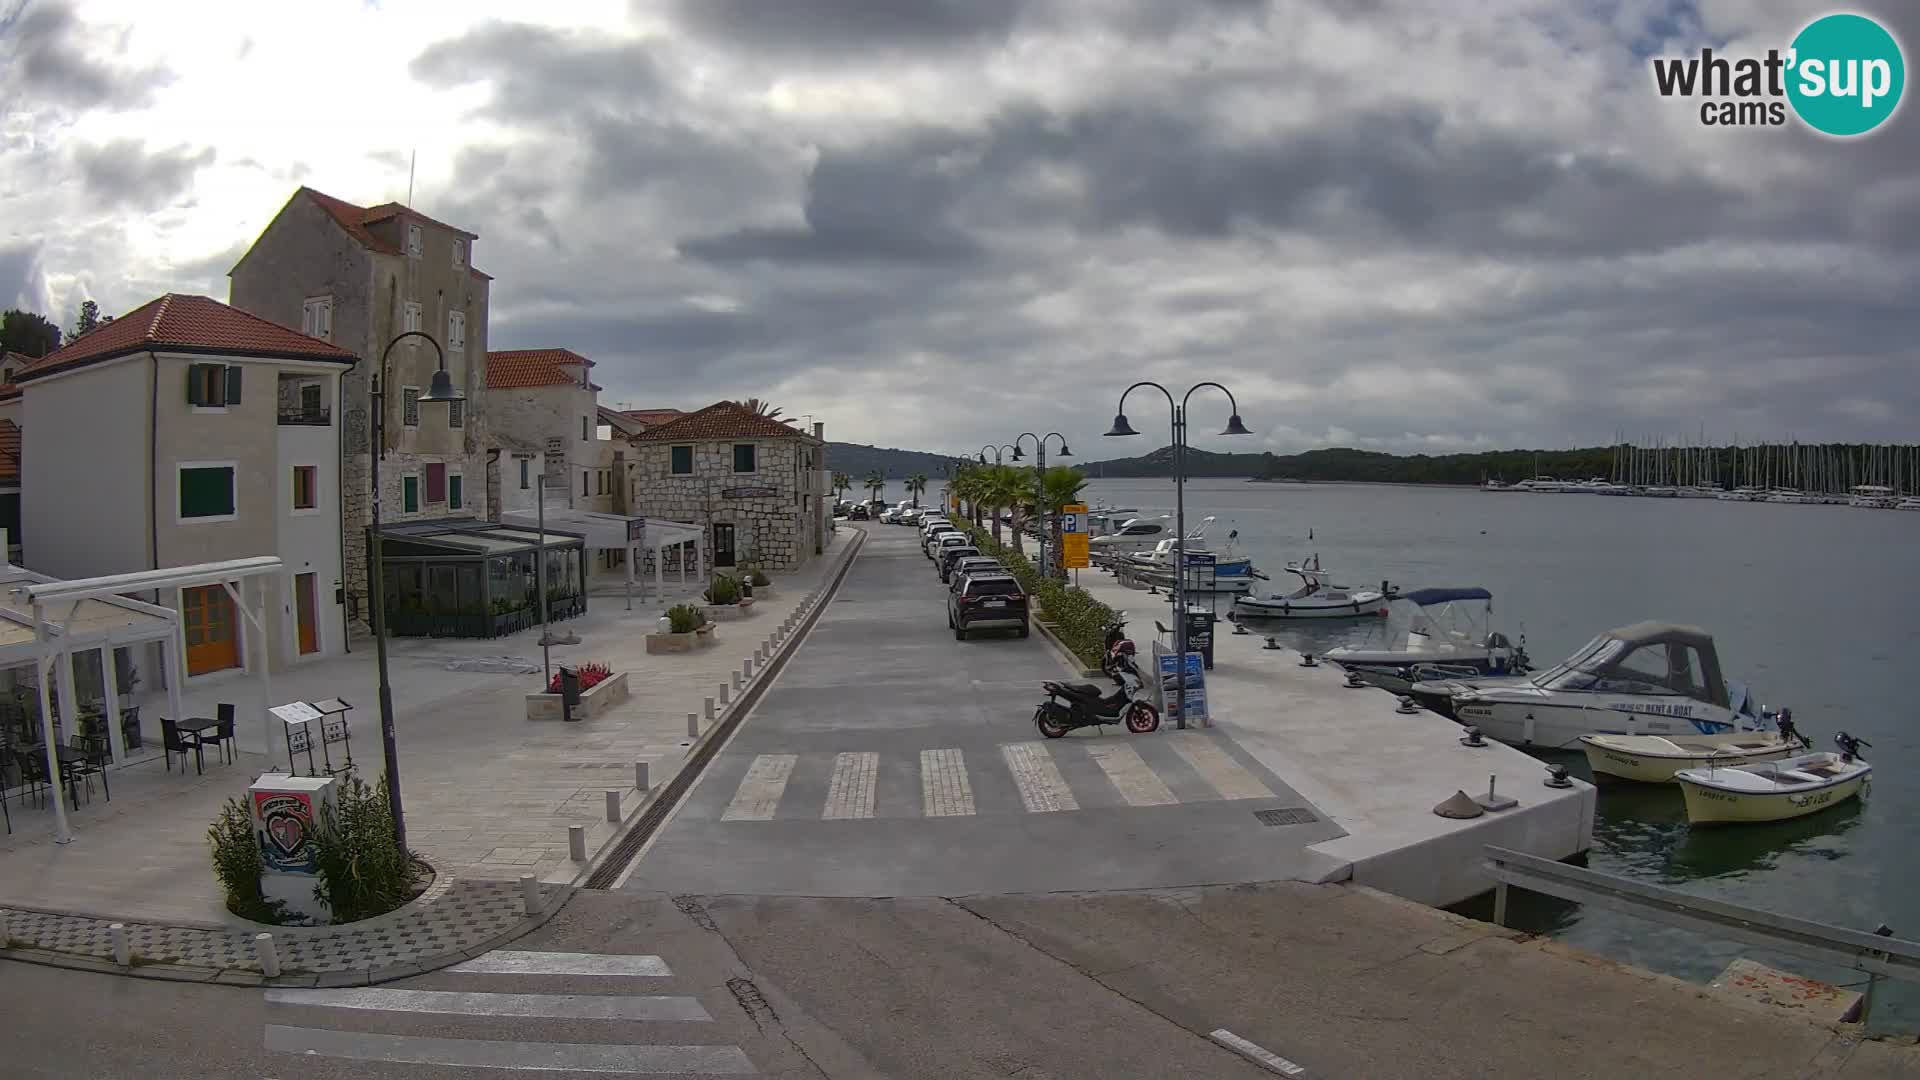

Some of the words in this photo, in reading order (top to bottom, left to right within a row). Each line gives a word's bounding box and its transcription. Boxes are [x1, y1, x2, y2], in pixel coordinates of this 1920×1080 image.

[1065, 514, 1075, 531] P
[1646, 704, 1665, 714] RENT
[1666, 704, 1672, 714] A
[1673, 705, 1692, 717] BOAT
